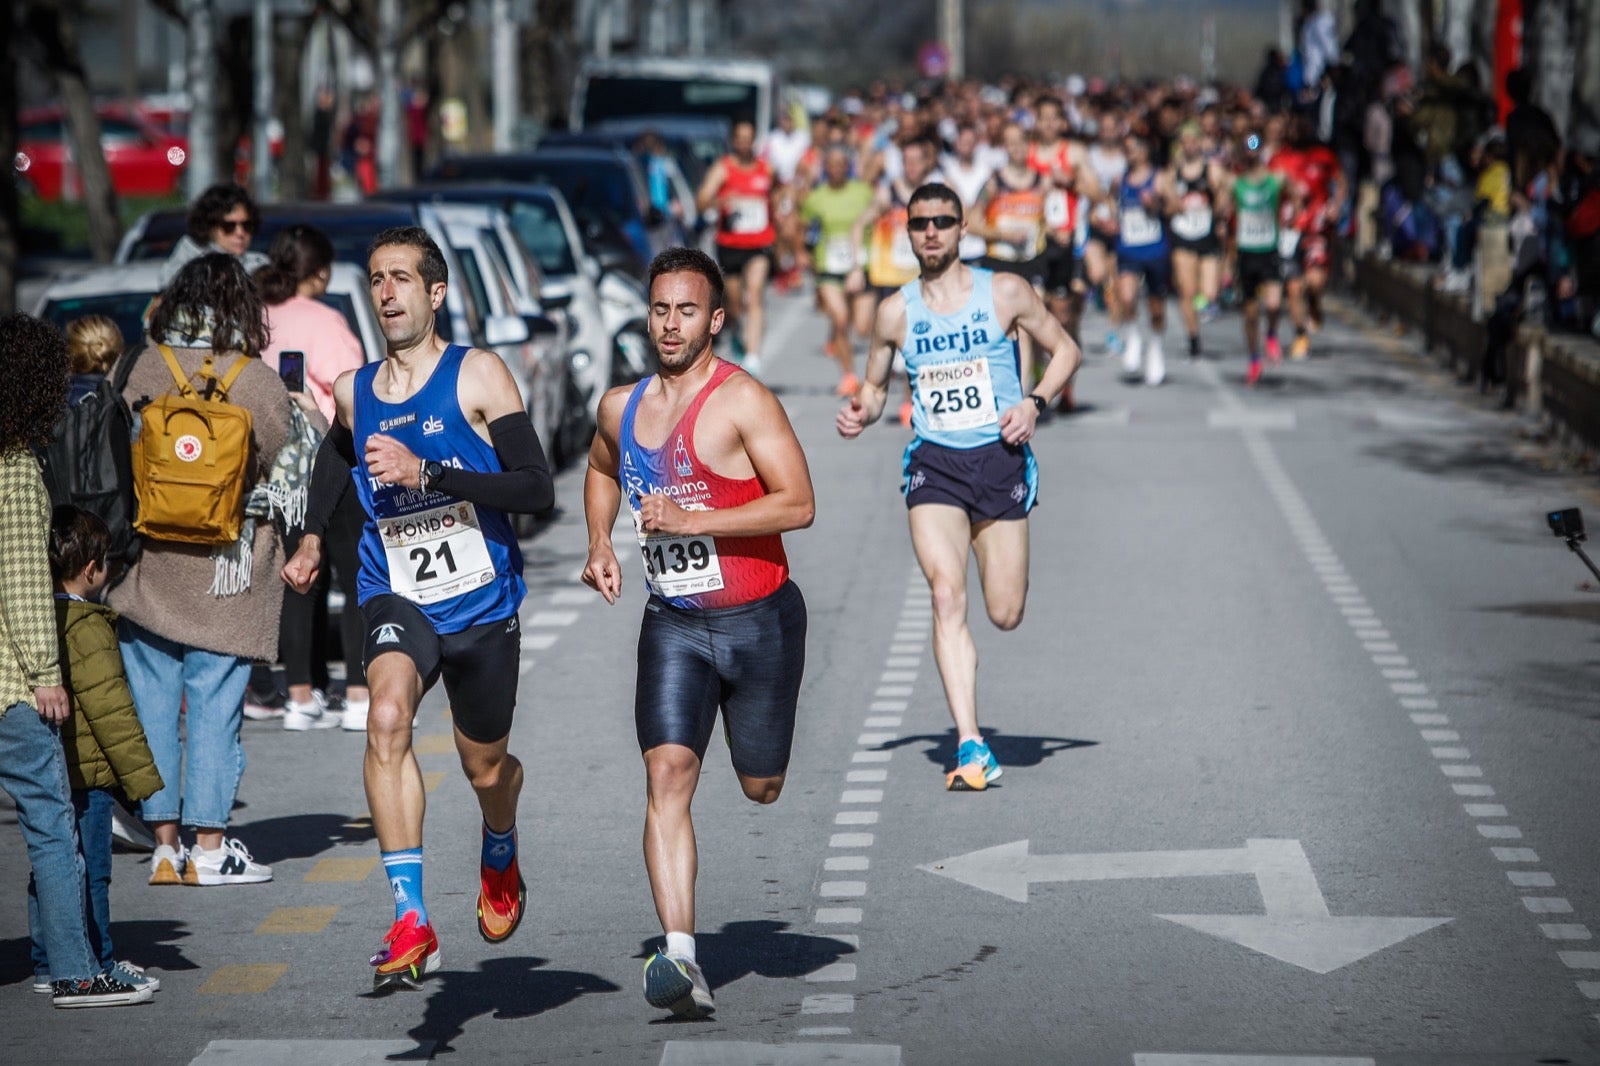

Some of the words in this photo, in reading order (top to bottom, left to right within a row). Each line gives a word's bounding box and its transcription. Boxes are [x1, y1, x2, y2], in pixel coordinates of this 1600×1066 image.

[915, 324, 990, 354] nerja
[929, 385, 982, 415] 258
[396, 514, 455, 538] FONDO
[409, 540, 458, 583] 21
[641, 541, 709, 575] 3139
